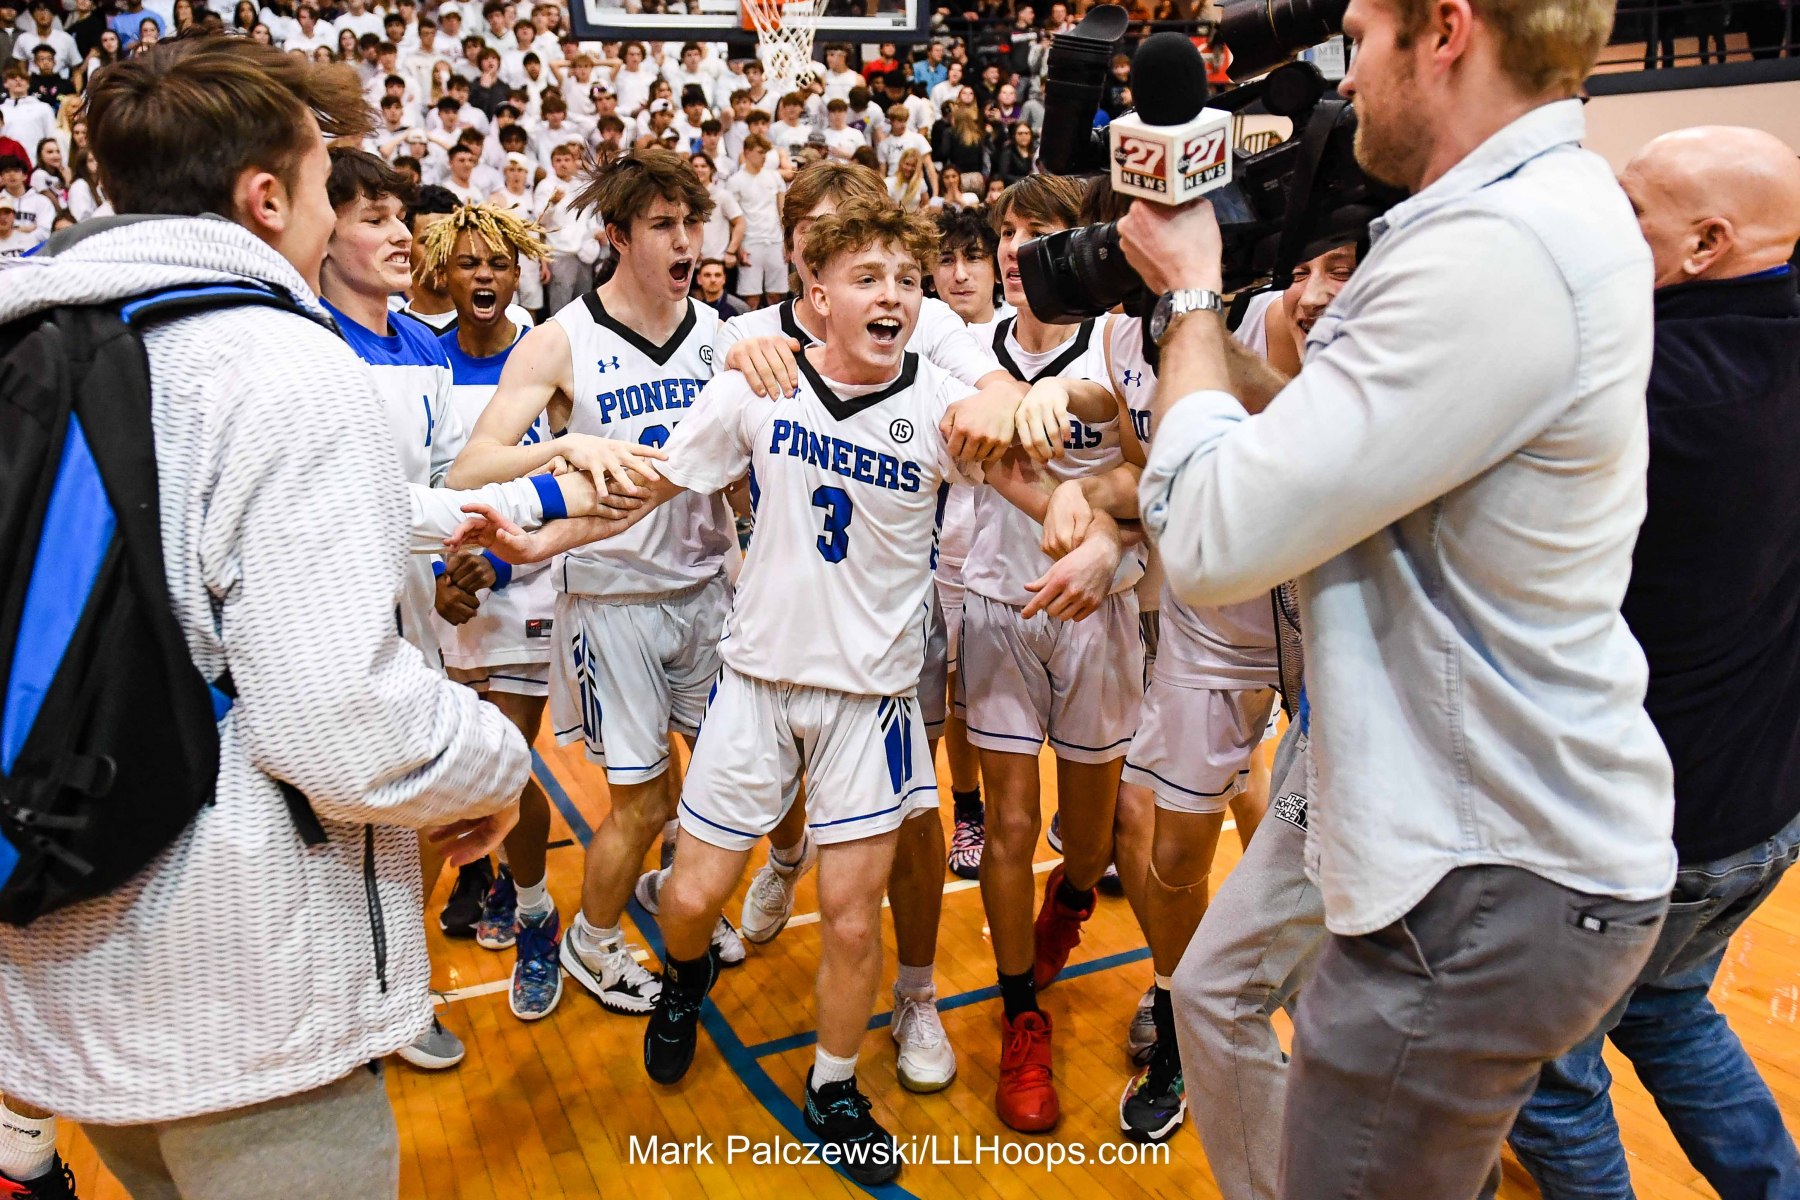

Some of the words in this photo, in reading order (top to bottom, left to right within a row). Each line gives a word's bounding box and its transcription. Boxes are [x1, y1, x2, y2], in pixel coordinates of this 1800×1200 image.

[1123, 138, 1164, 174] 27
[1186, 131, 1225, 171] 27
[1122, 172, 1166, 192] NEWS
[1185, 163, 1225, 190] NEWS
[894, 422, 909, 439] 15
[811, 484, 854, 564] 3
[1275, 799, 1299, 814] NORTH
[1289, 794, 1305, 807] THE
